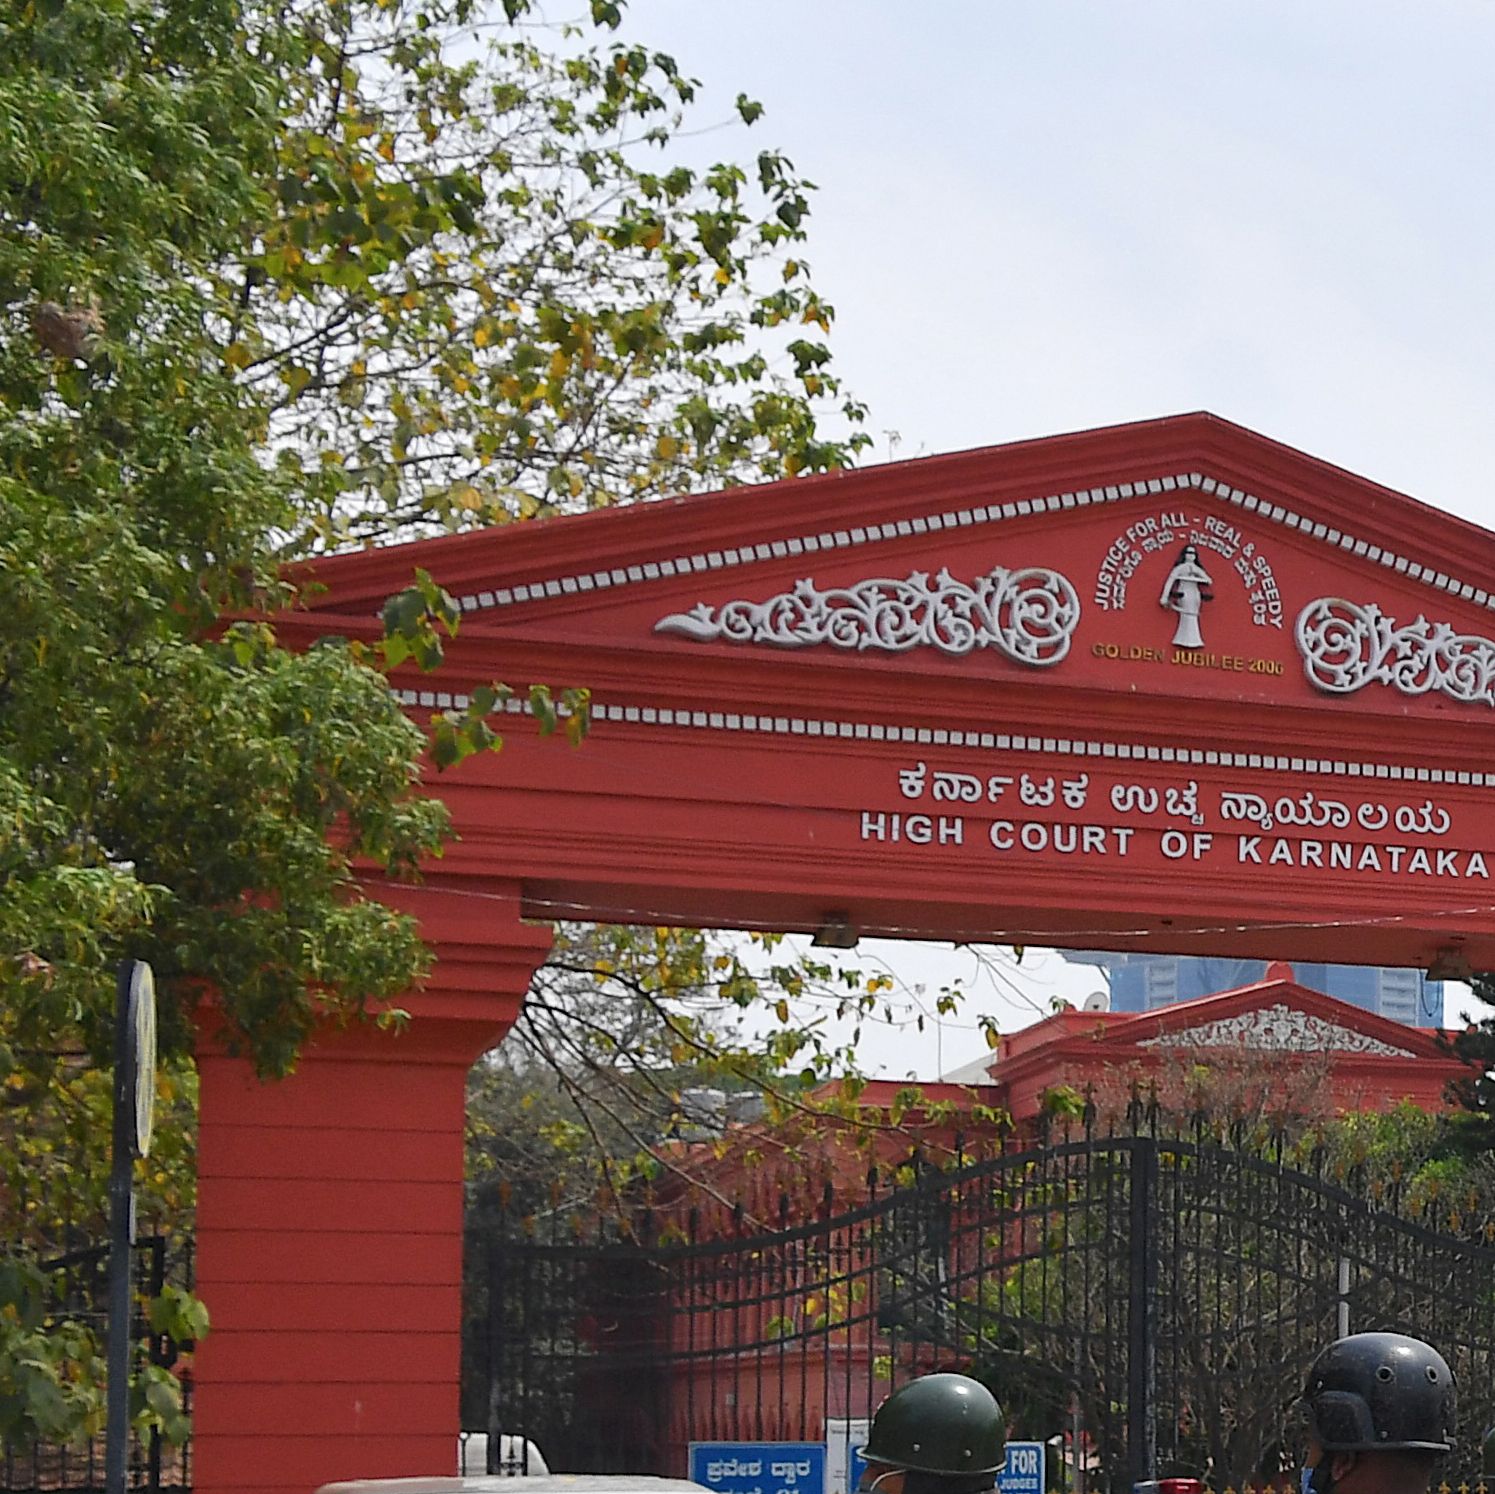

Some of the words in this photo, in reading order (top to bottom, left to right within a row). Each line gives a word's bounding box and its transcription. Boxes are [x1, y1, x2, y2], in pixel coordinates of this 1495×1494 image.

[1095, 537, 1130, 610] JUSTICE
[1126, 517, 1159, 542] FOR
[1161, 512, 1189, 529] ALL
[1204, 515, 1242, 547] REAL
[1242, 543, 1255, 557] &
[1253, 556, 1283, 629] SPEEDY
[1092, 642, 1165, 664] GOLDEN
[1171, 651, 1244, 671] JUBILEE
[899, 762, 1089, 809] ಕರ್ನಾಟಕ
[1220, 791, 1450, 834] ನ್ಯಾಯಾಲಯ
[861, 812, 963, 844] HIGH
[989, 821, 1134, 855] COURT
[1161, 831, 1213, 859] OF
[1238, 836, 1489, 878] KARNATAKA
[707, 1458, 762, 1483] ಪ್ರವೇಶ
[1011, 1450, 1037, 1474] FOR
